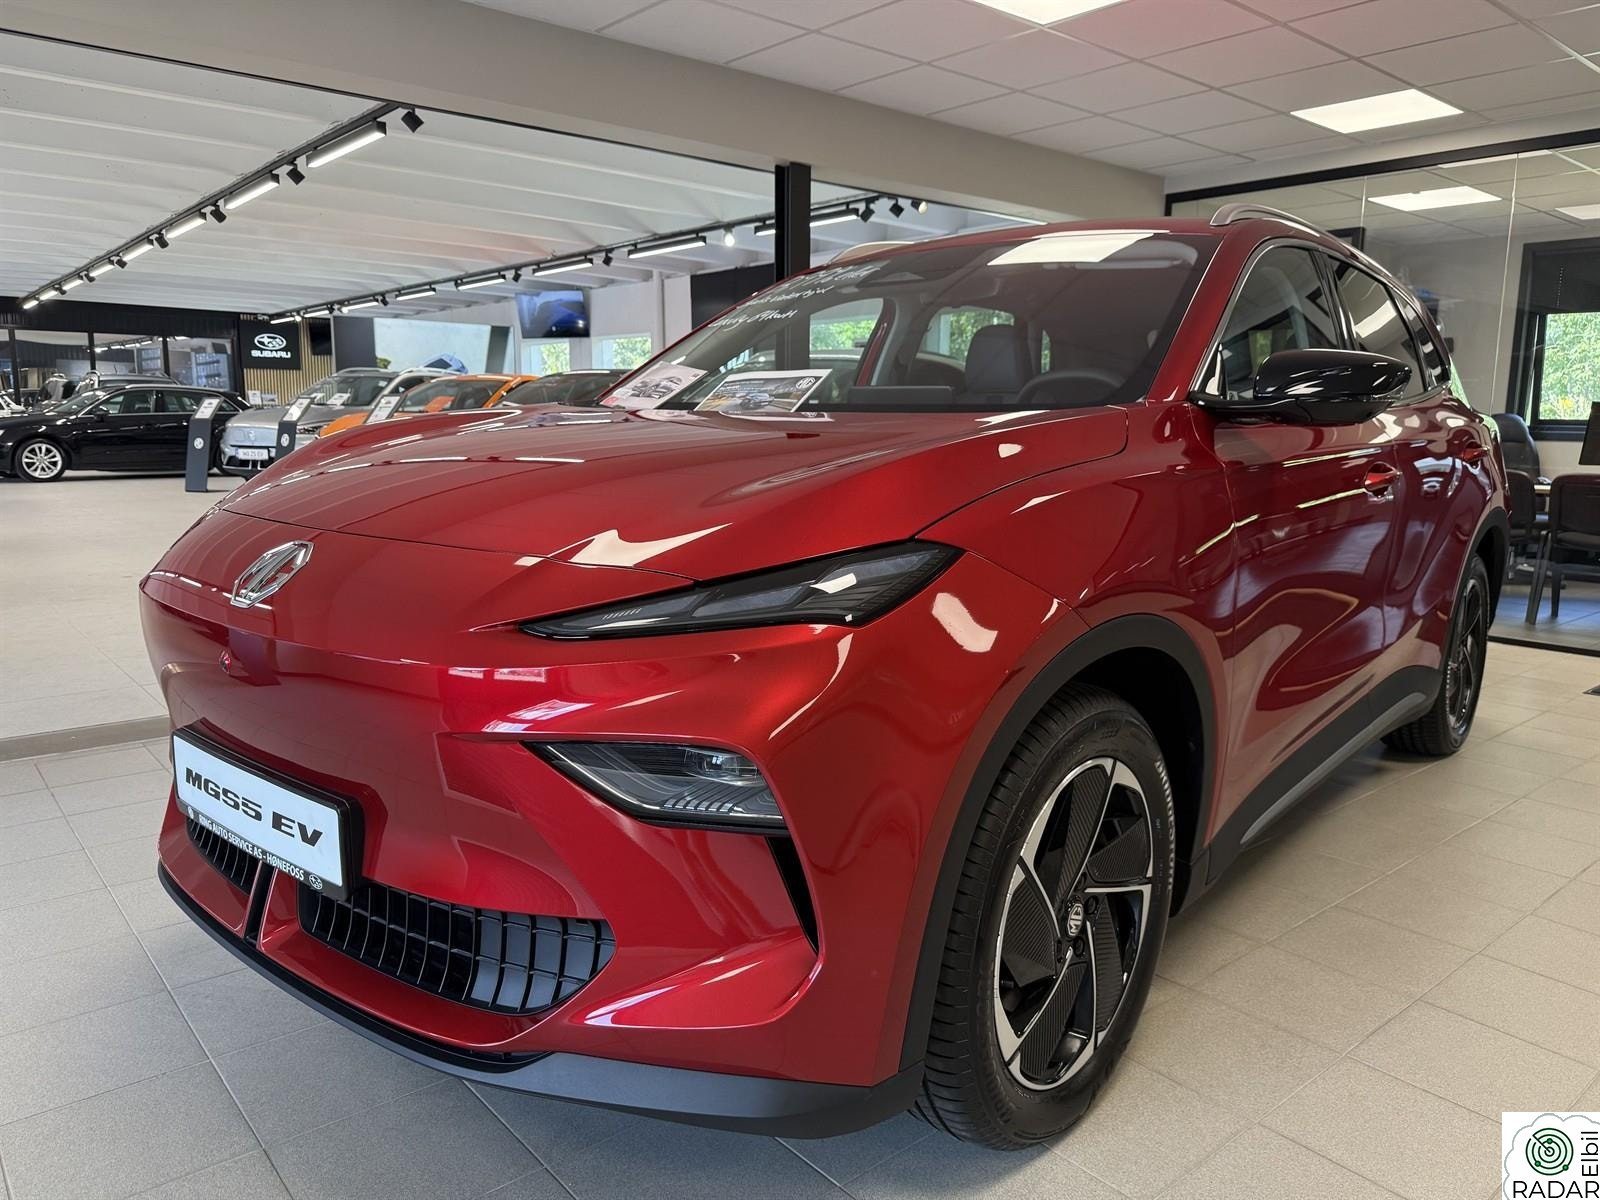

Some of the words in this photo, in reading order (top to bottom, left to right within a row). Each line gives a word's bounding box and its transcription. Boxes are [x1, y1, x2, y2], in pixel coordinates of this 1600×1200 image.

[251, 350, 291, 358] SUBARU
[185, 767, 263, 822] MGS5
[271, 811, 323, 847] EV
[212, 823, 228, 839] AUTO
[228, 832, 253, 854] SERVICE
[253, 847, 262, 859] AS
[266, 853, 305, 881] HØNEFOSS
